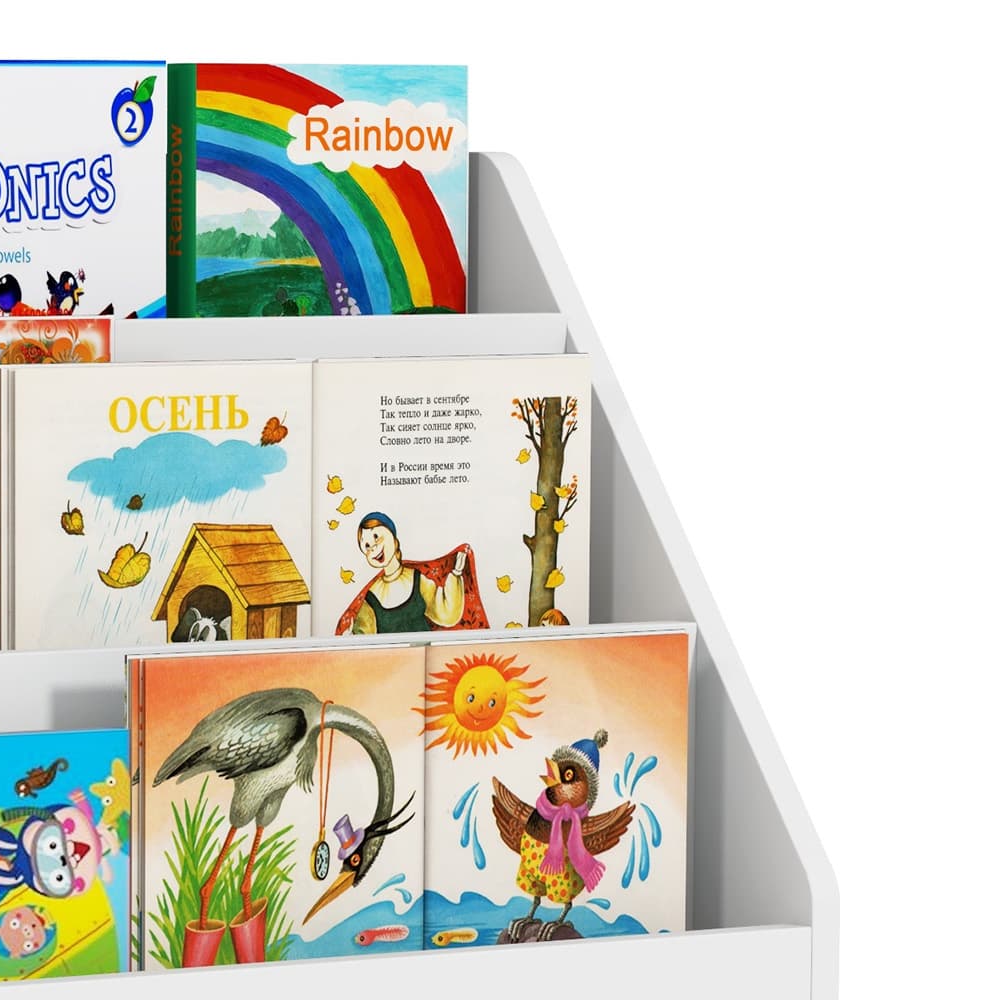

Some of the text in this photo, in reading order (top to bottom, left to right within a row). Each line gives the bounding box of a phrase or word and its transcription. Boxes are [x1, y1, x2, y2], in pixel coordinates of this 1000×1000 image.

[123, 106, 138, 134] 2
[305, 117, 454, 152] Rainbow
[168, 124, 183, 256] Rainbow
[380, 396, 393, 405] Но
[396, 396, 424, 405] бывает
[434, 394, 470, 405] сентябре
[109, 394, 249, 433] ОСЕНЬ
[380, 409, 395, 419] Так
[398, 410, 421, 418] тепло
[432, 409, 451, 418] даже
[380, 422, 395, 432] Так
[423, 423, 451, 432] солнце
[380, 436, 411, 446] Словно
[413, 437, 431, 445] лето
[434, 436, 444, 444] на
[398, 462, 427, 472] России
[431, 462, 454, 472] время
[457, 462, 470, 470] это
[380, 476, 422, 486] Называют
[424, 474, 446, 484] бабье
